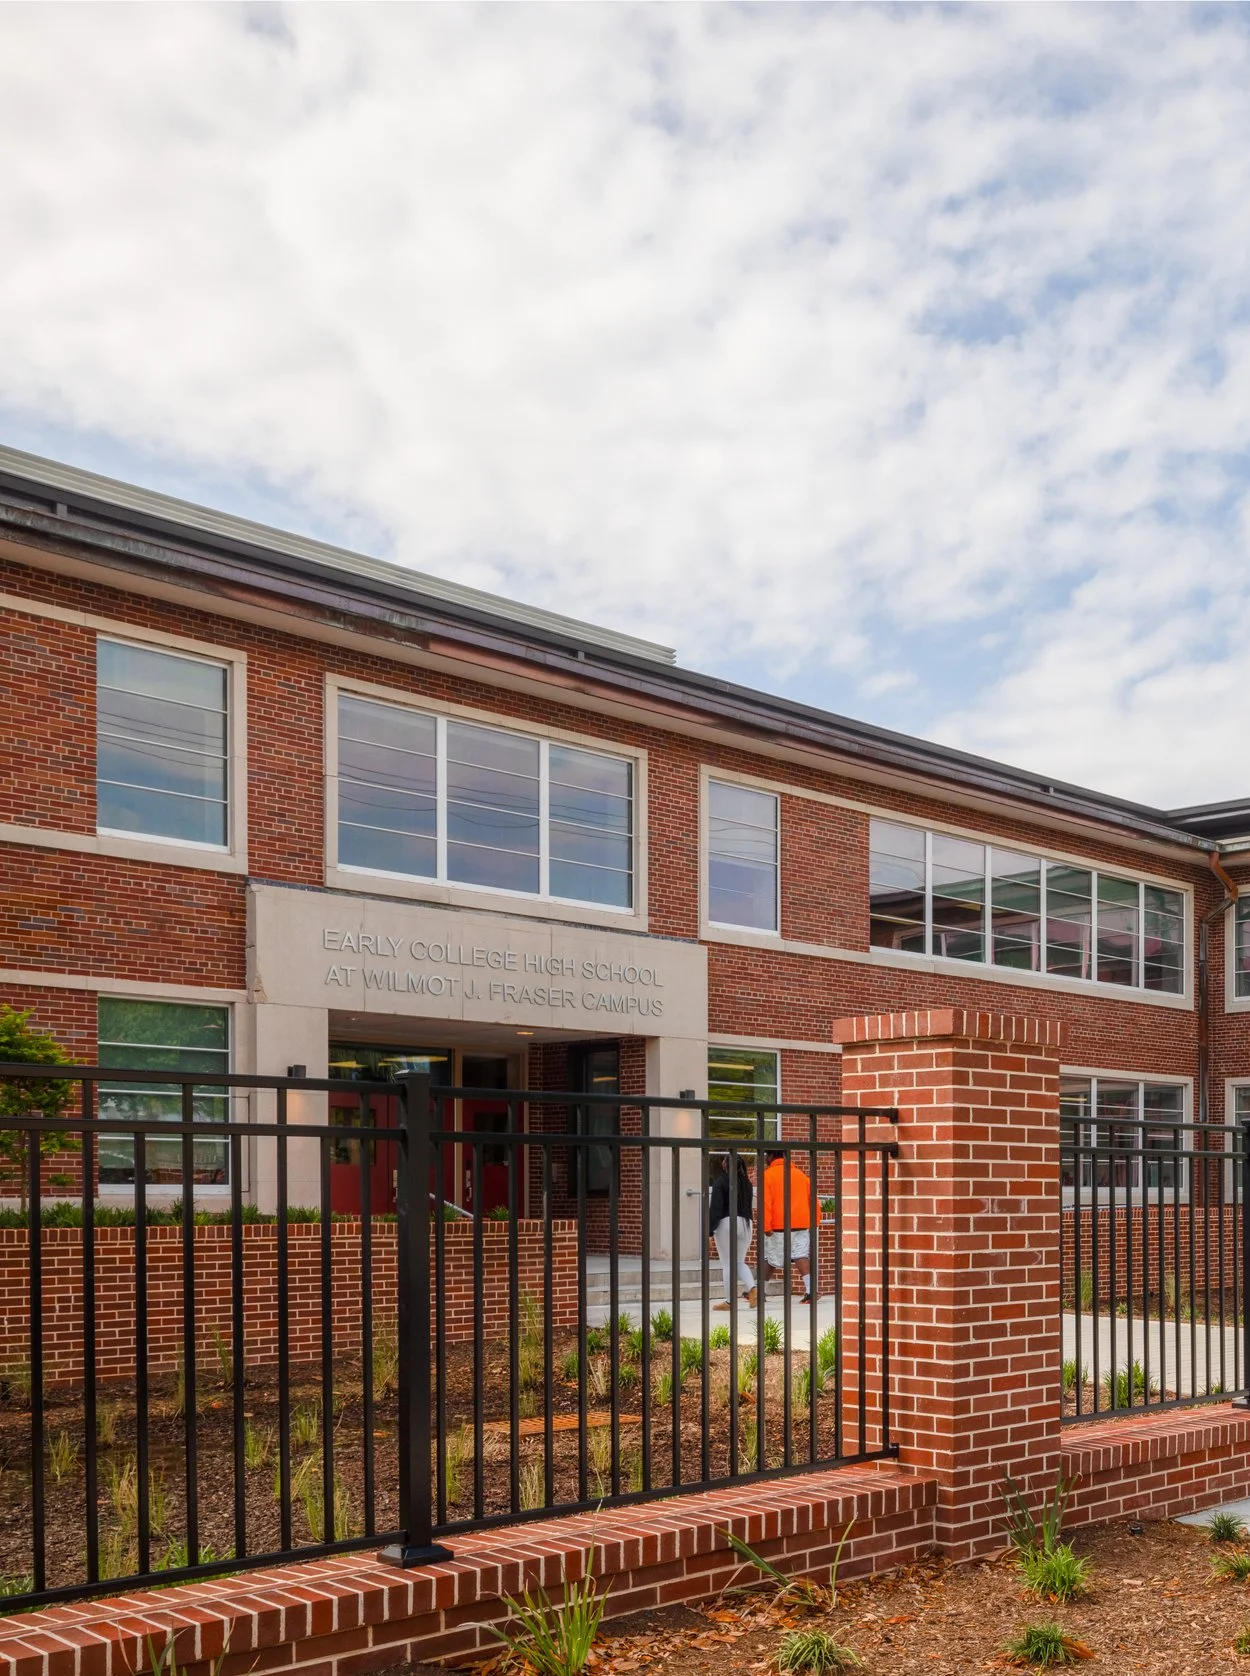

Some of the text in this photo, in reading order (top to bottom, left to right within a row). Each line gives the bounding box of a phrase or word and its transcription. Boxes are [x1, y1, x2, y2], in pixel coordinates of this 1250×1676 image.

[323, 928, 664, 987] EARLY COLLEGE HIGH SCHOOL
[324, 965, 664, 1017] AT WILMOT J. FRASER CAMPUS
